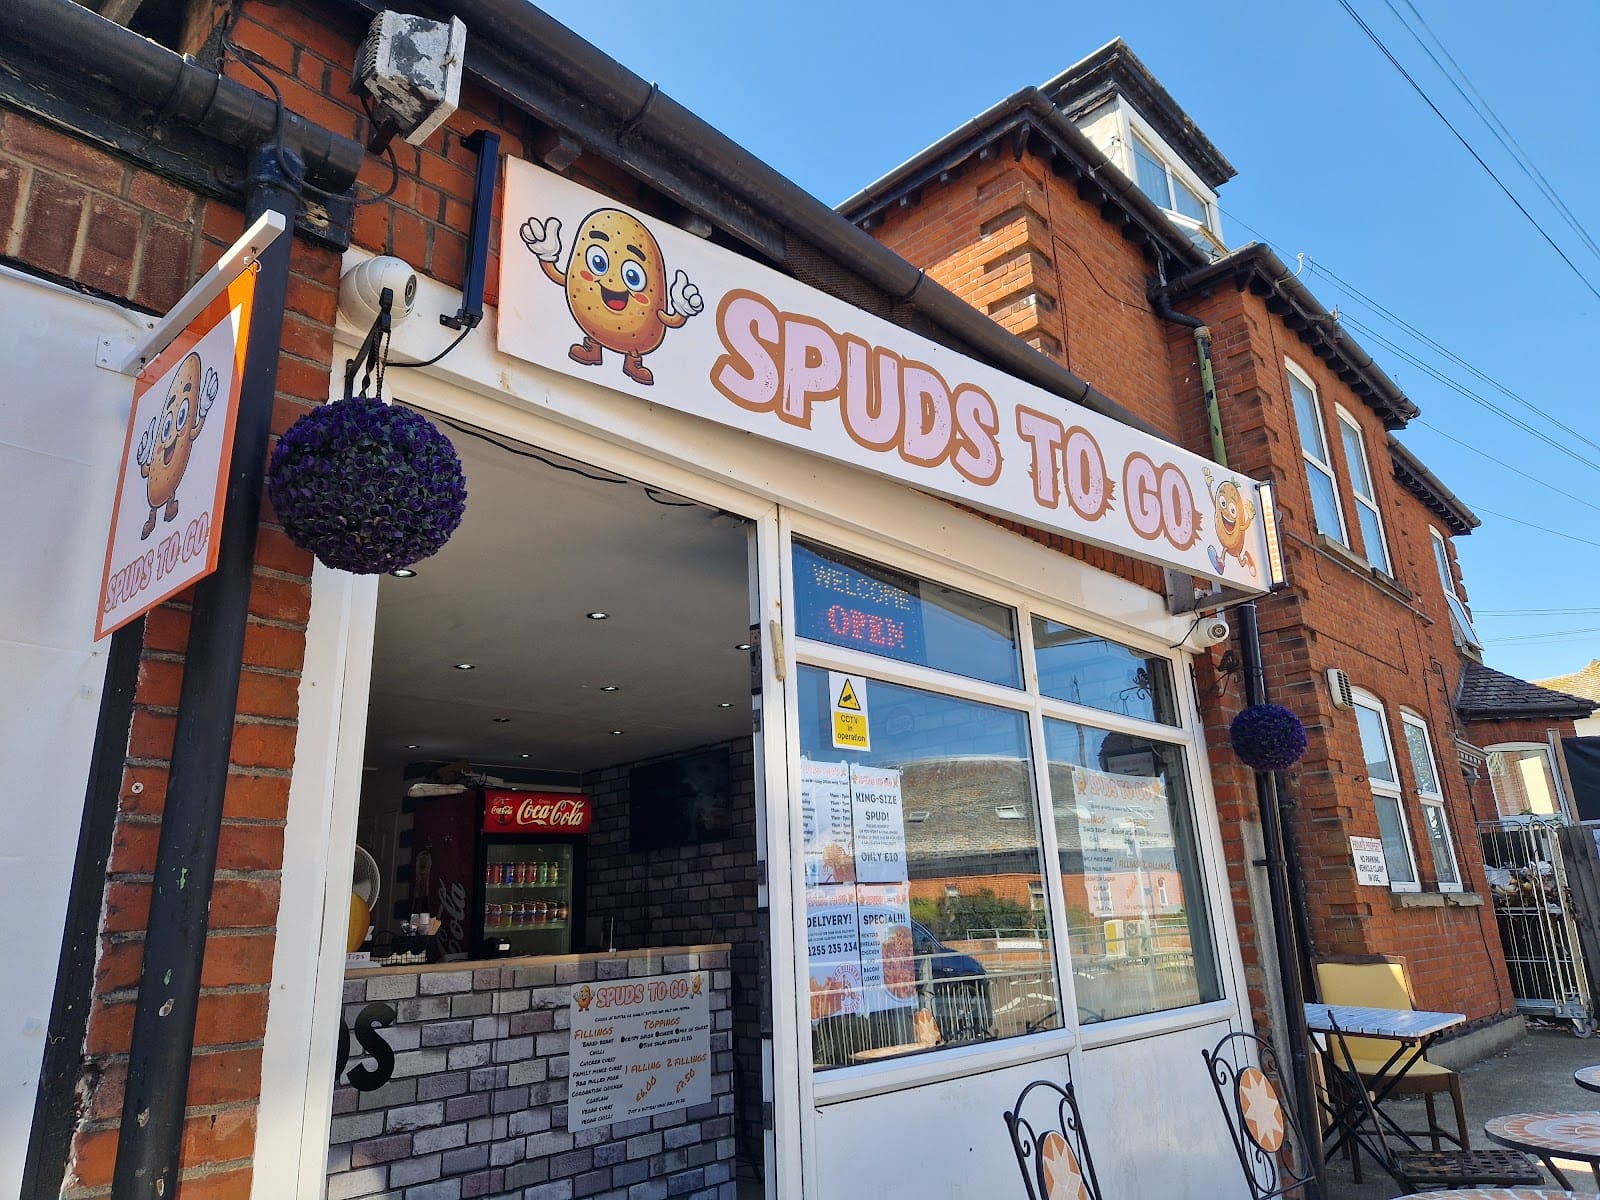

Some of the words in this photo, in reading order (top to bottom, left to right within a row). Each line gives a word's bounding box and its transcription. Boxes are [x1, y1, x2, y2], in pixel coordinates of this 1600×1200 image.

[710, 288, 1003, 487] SPUDS
[1015, 403, 1116, 522] TO
[1122, 451, 1203, 552] GO
[104, 549, 154, 613] SPUDS
[157, 531, 181, 581] TO
[182, 512, 210, 563] GO
[812, 563, 911, 611] WELCOME
[827, 604, 905, 649] OPEN
[840, 714, 858, 725] CCTV
[837, 732, 866, 744] operation
[855, 792, 897, 805] KING-SIZE
[516, 799, 584, 825] Coca-Cola
[866, 811, 889, 821] SPUD!
[861, 852, 881, 862] ONLY
[885, 852, 899, 862] £10
[807, 914, 852, 928] DELIVERY!
[863, 913, 906, 925] SPECIAL!!!
[828, 944, 841, 955] 235
[843, 942, 857, 953] 234
[596, 984, 644, 1008] SPUDS
[648, 981, 668, 1002] TO
[670, 979, 688, 999] GO
[643, 1017, 680, 1030] TOPPINGS
[574, 1027, 614, 1040] FILLINGS
[625, 1065, 628, 1074] 1
[631, 1062, 661, 1073] FILLING
[667, 1058, 672, 1067] 2
[675, 1053, 706, 1066] FILLINGS
